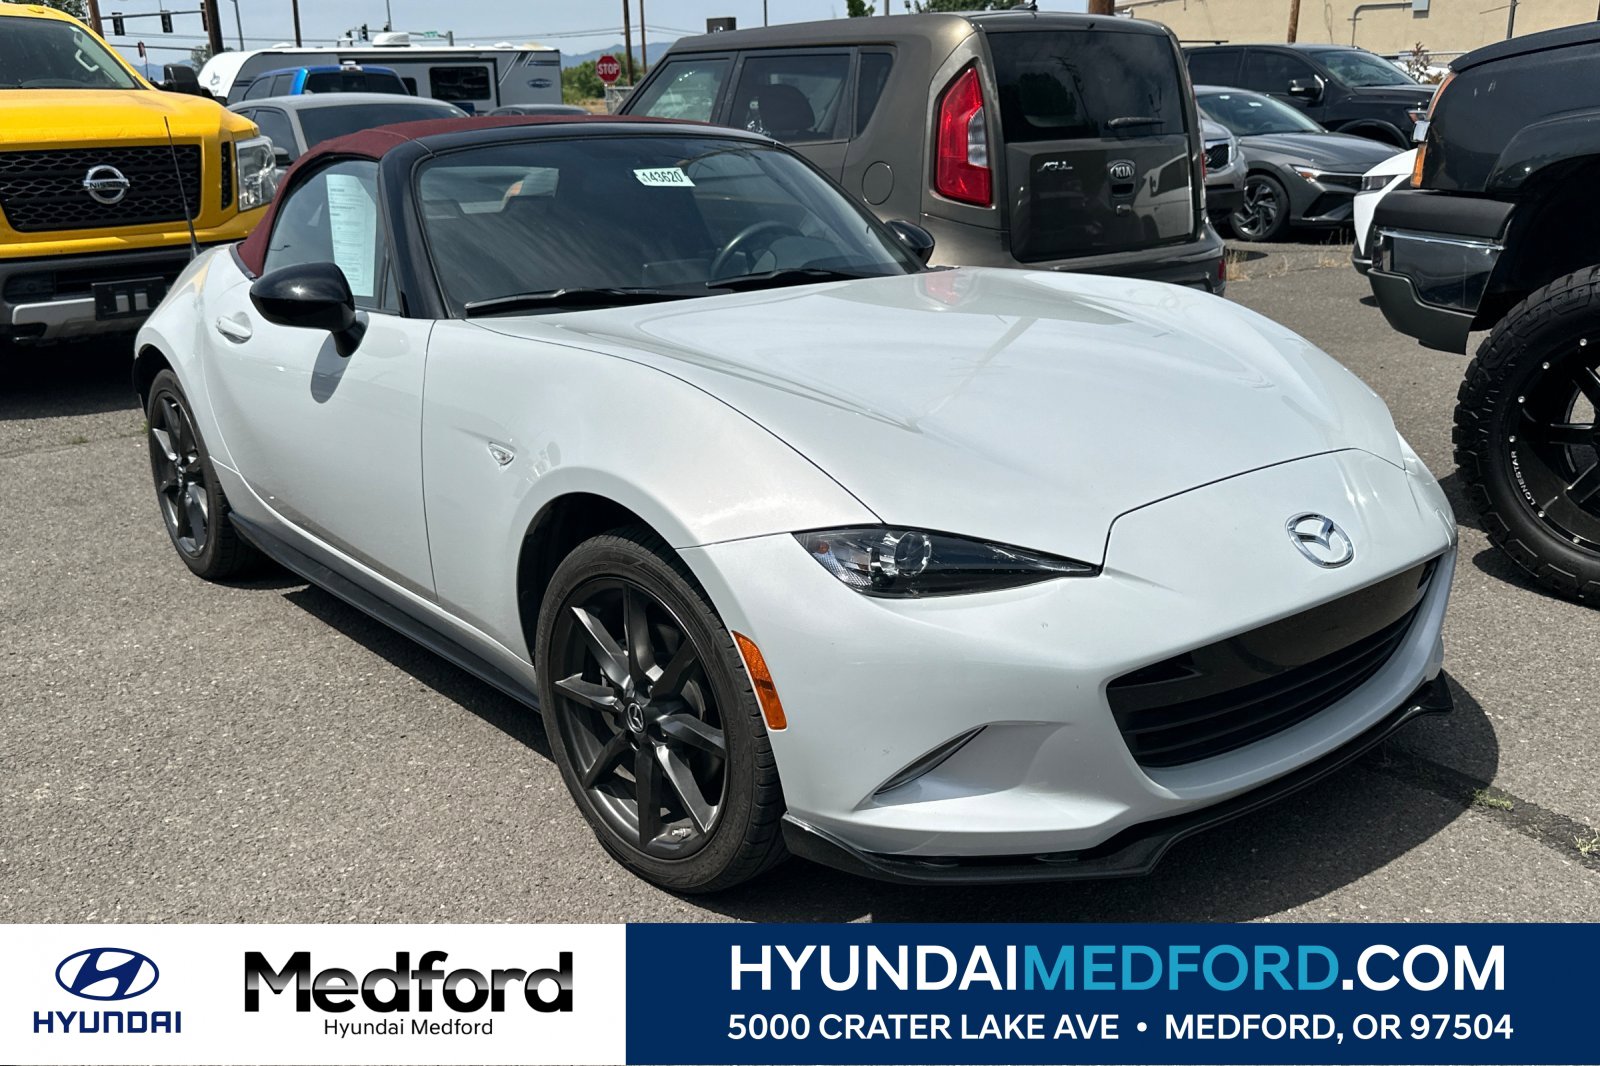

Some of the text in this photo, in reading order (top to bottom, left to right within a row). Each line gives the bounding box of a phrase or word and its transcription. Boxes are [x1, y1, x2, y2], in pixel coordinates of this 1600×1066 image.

[598, 63, 619, 75] STOP
[642, 171, 684, 183] 143620
[1115, 166, 1131, 177] KIA
[89, 181, 125, 189] NISSAN
[1510, 450, 1536, 506] LONESTAR
